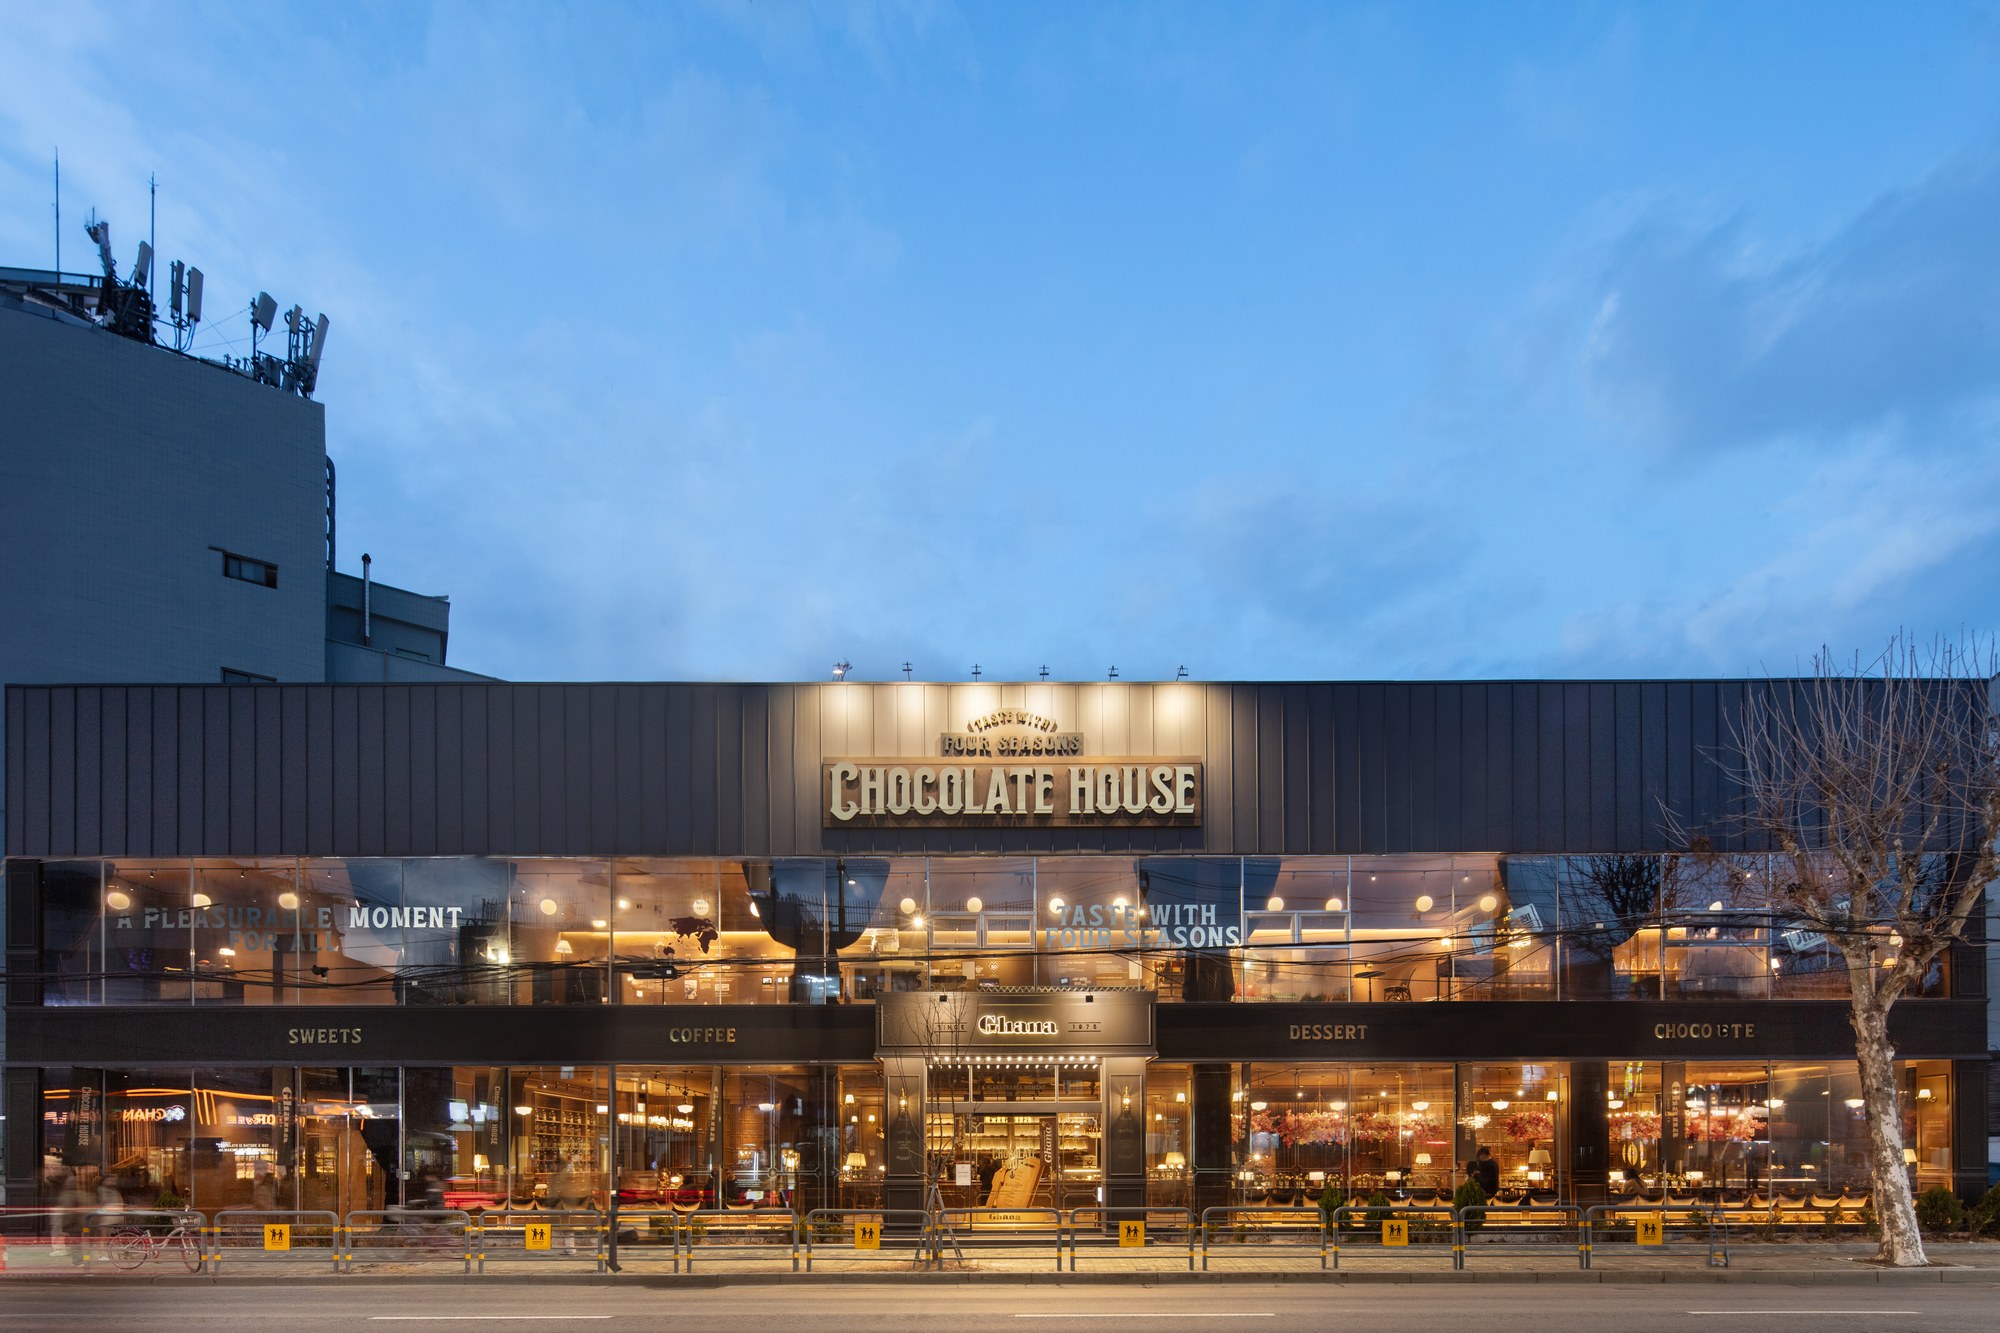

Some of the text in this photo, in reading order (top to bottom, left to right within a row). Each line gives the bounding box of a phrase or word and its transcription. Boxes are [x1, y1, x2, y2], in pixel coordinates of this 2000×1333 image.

[974, 711, 1051, 732] TASTE WITH
[943, 735, 1081, 753] FOUR SEASONS
[830, 761, 1196, 821] CHOCOLATE HOUSE
[117, 909, 133, 929] A
[349, 907, 463, 929] MOMENT
[1057, 904, 1217, 926] TASTE WITH
[229, 930, 339, 952] FOR ALL
[1045, 926, 1240, 948] FOUR SEASONS
[669, 1027, 737, 1043] COFFEE
[977, 1014, 1059, 1035] Ghana
[1289, 1024, 1368, 1040] DESSERT
[1654, 1023, 1755, 1039] CHOCOLTE
[289, 1028, 362, 1044] SWEETS
[992, 1148, 1036, 1160] CHOOLATE
[1044, 1126, 1052, 1163] Ghana
